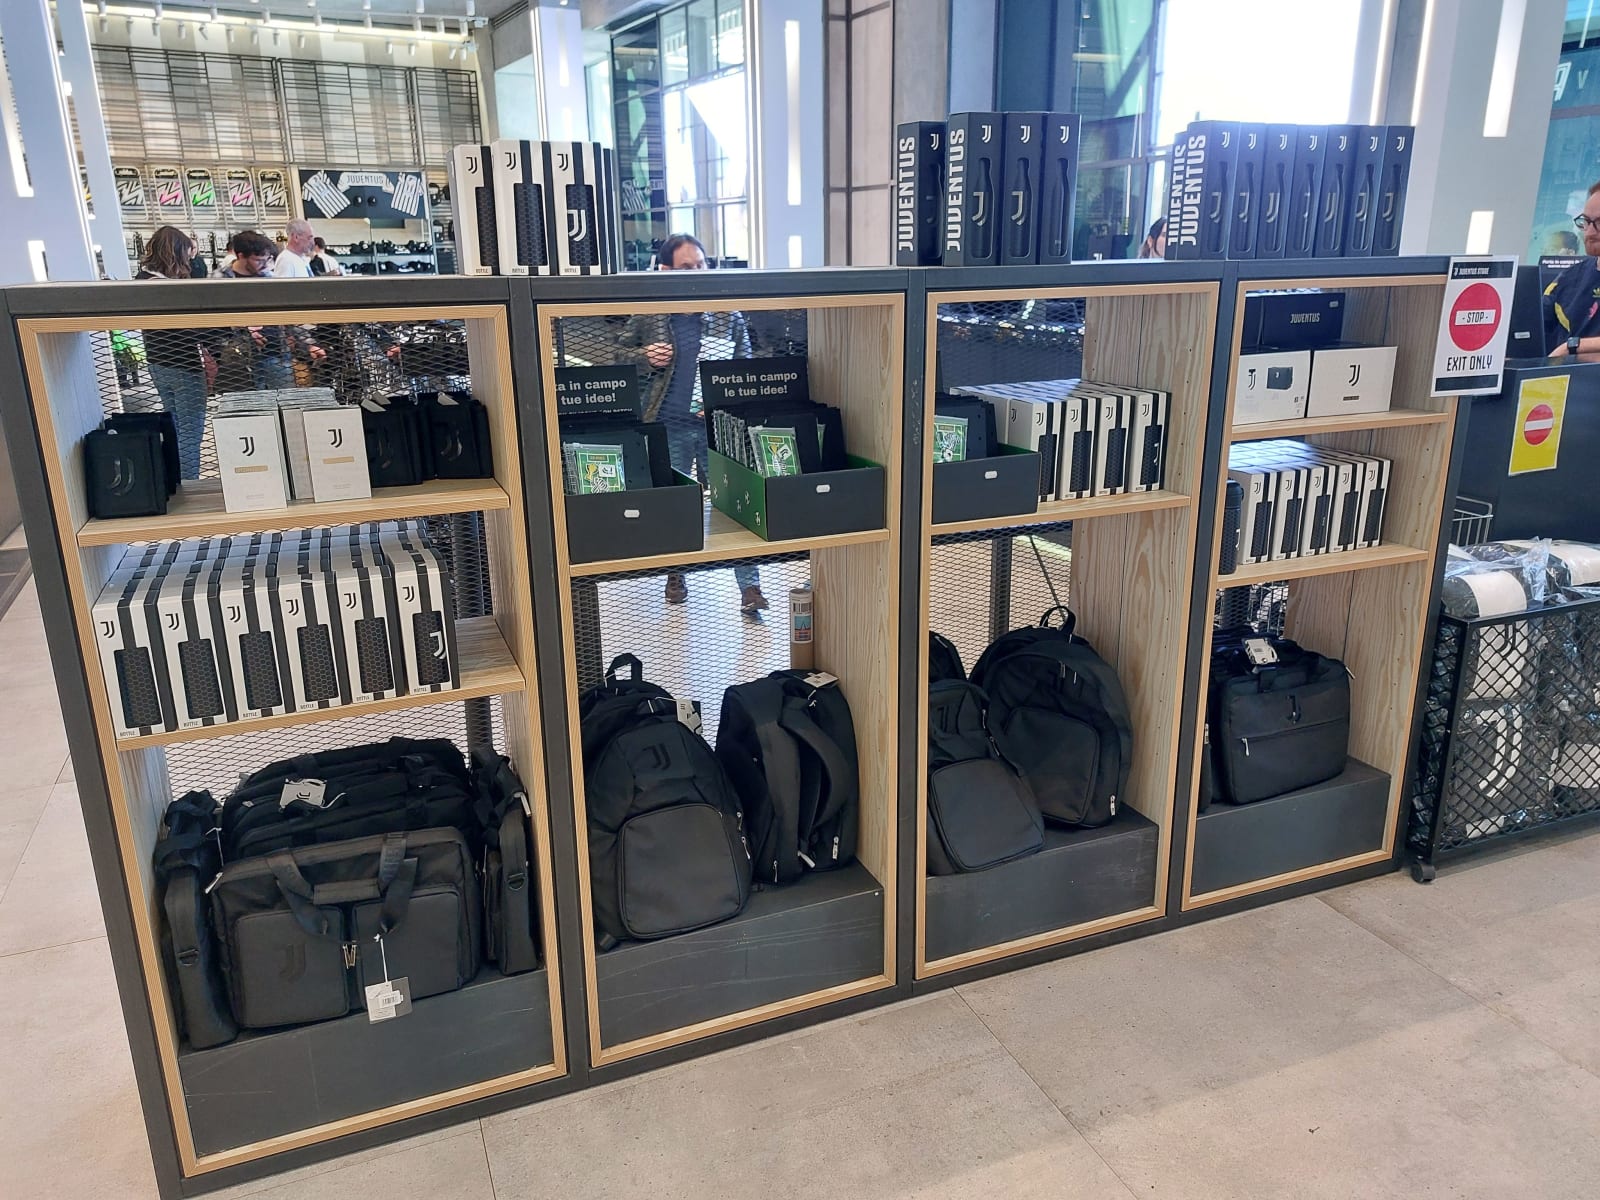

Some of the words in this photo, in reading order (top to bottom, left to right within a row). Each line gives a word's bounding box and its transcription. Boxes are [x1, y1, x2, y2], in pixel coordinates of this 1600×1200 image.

[898, 136, 915, 252] JUVENTUS
[946, 128, 965, 252] JUVENTUS
[1180, 134, 1206, 247] JUVENTUS
[1290, 313, 1321, 324] JUVENTUS
[1466, 311, 1485, 323] STOP
[1446, 356, 1467, 372] EXIT
[1470, 354, 1493, 371] ONLY
[569, 380, 582, 391] in
[584, 379, 627, 391] campo
[711, 374, 744, 385] Porta
[746, 373, 757, 383] in
[759, 372, 798, 383] campo
[724, 387, 736, 397] le
[738, 387, 757, 396] tue
[760, 384, 788, 395] idee!
[560, 395, 582, 405] tue
[585, 392, 616, 404] idee!
